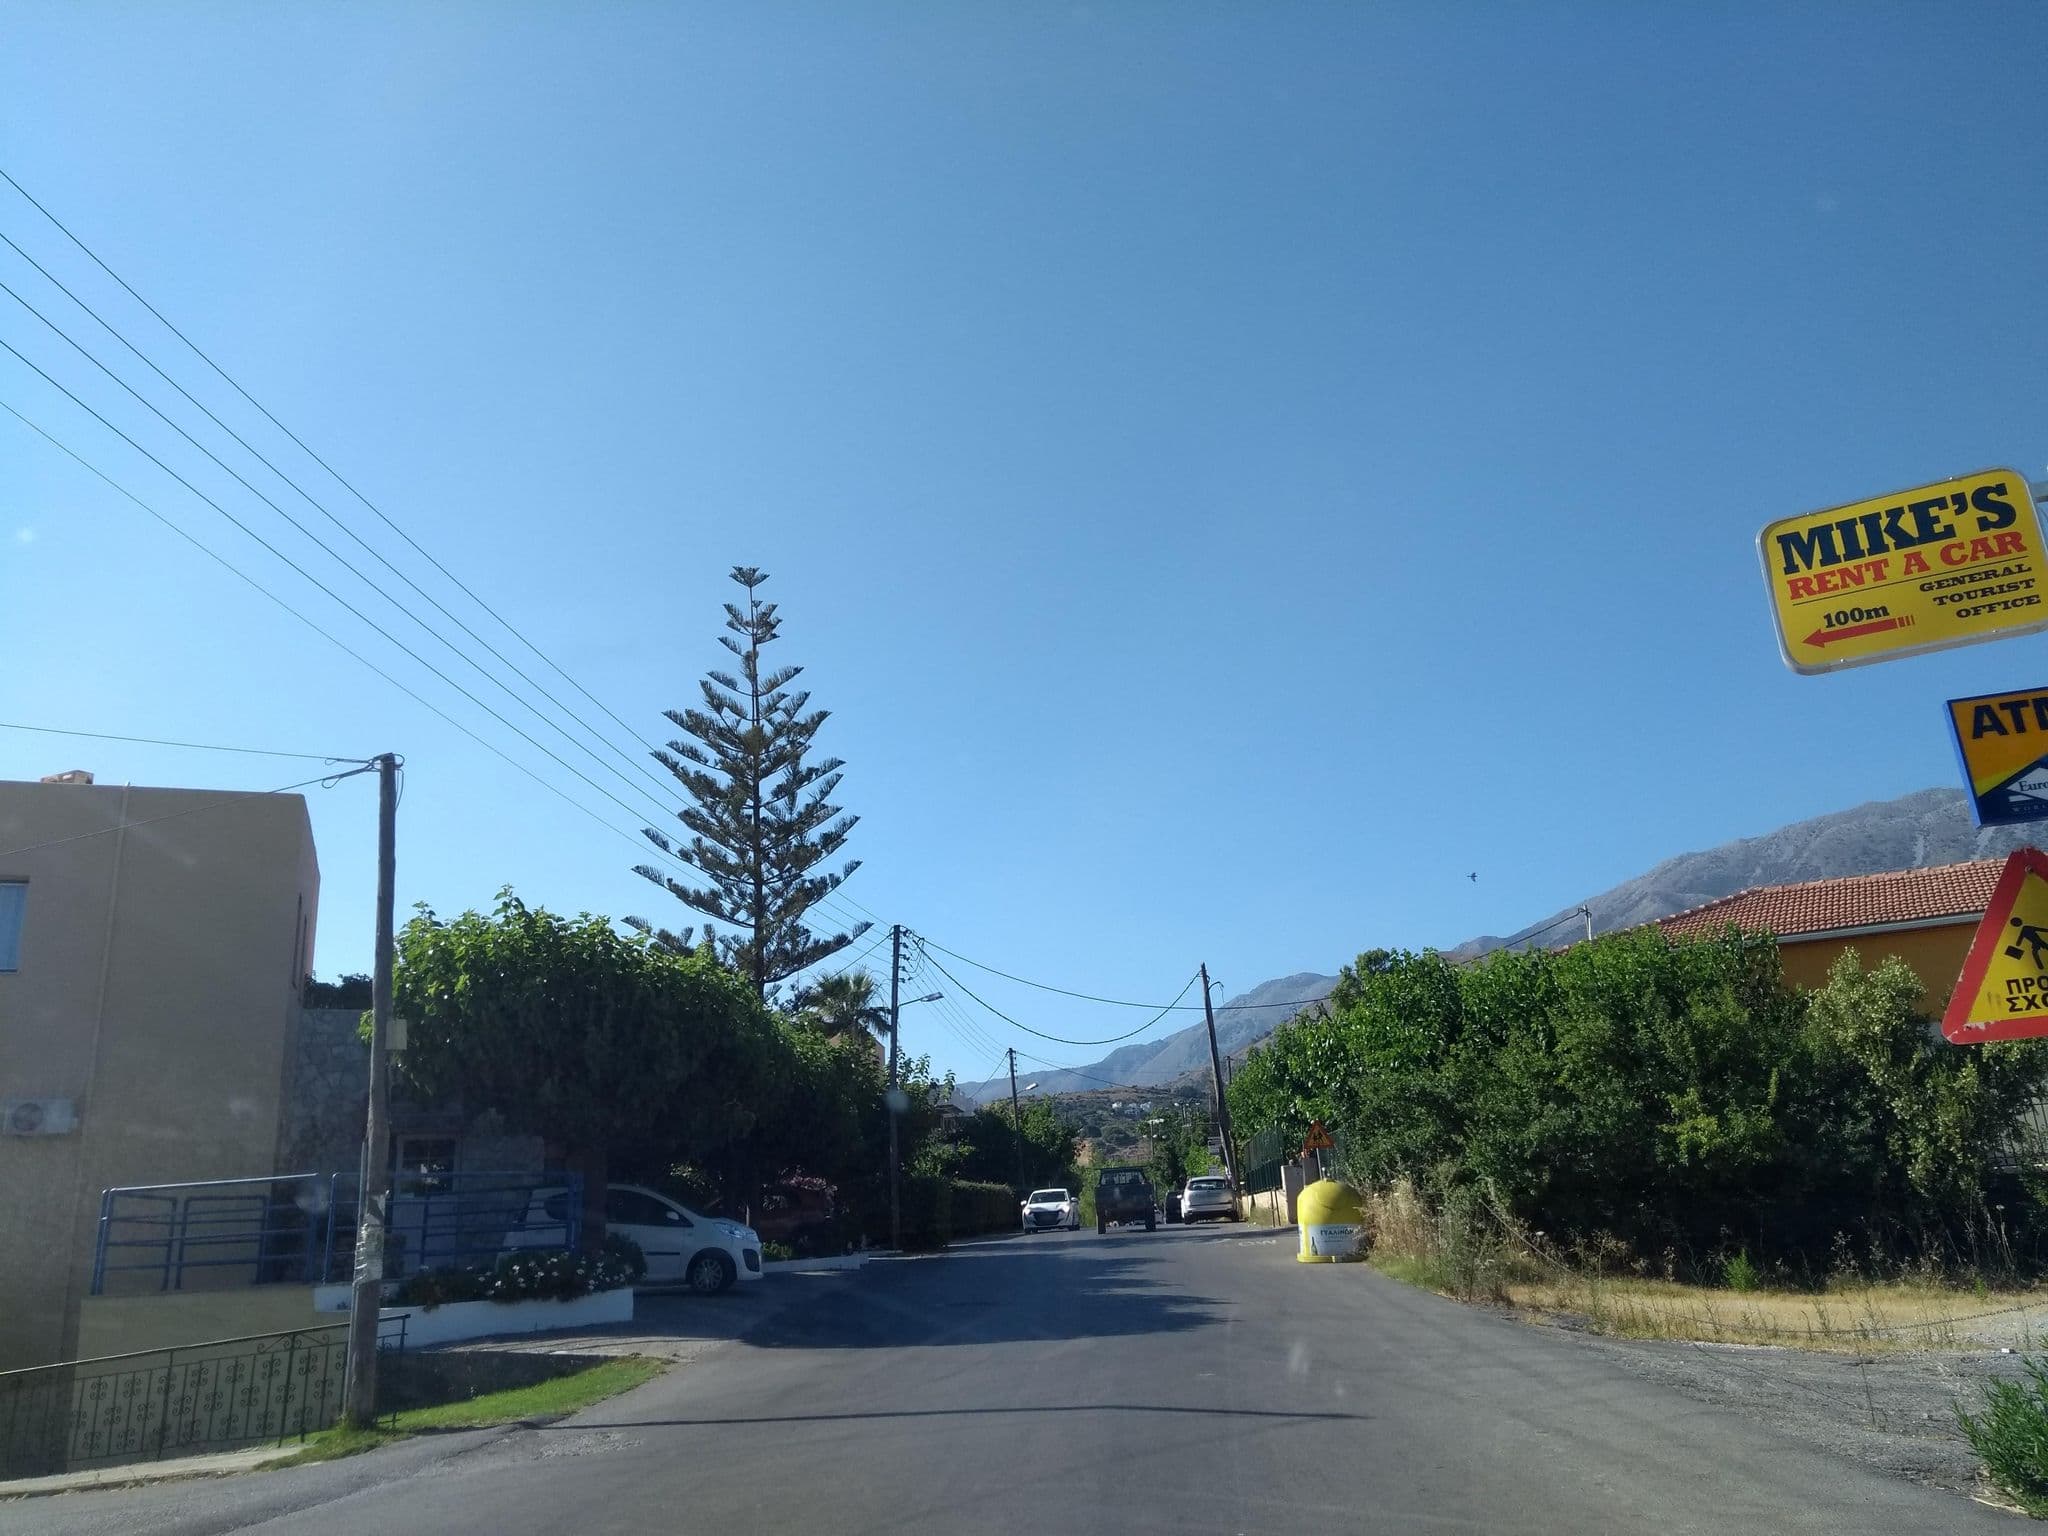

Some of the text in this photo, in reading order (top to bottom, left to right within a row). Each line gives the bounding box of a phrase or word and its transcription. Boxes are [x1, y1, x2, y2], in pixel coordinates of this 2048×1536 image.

[1777, 483, 2016, 575] MIKE'S
[1787, 531, 2027, 600] RENT A CAR
[1919, 563, 2032, 592] GENERAL
[1932, 578, 2035, 605] TOURIST
[1823, 605, 1889, 628] 100m
[1955, 594, 2041, 618] OFFICE
